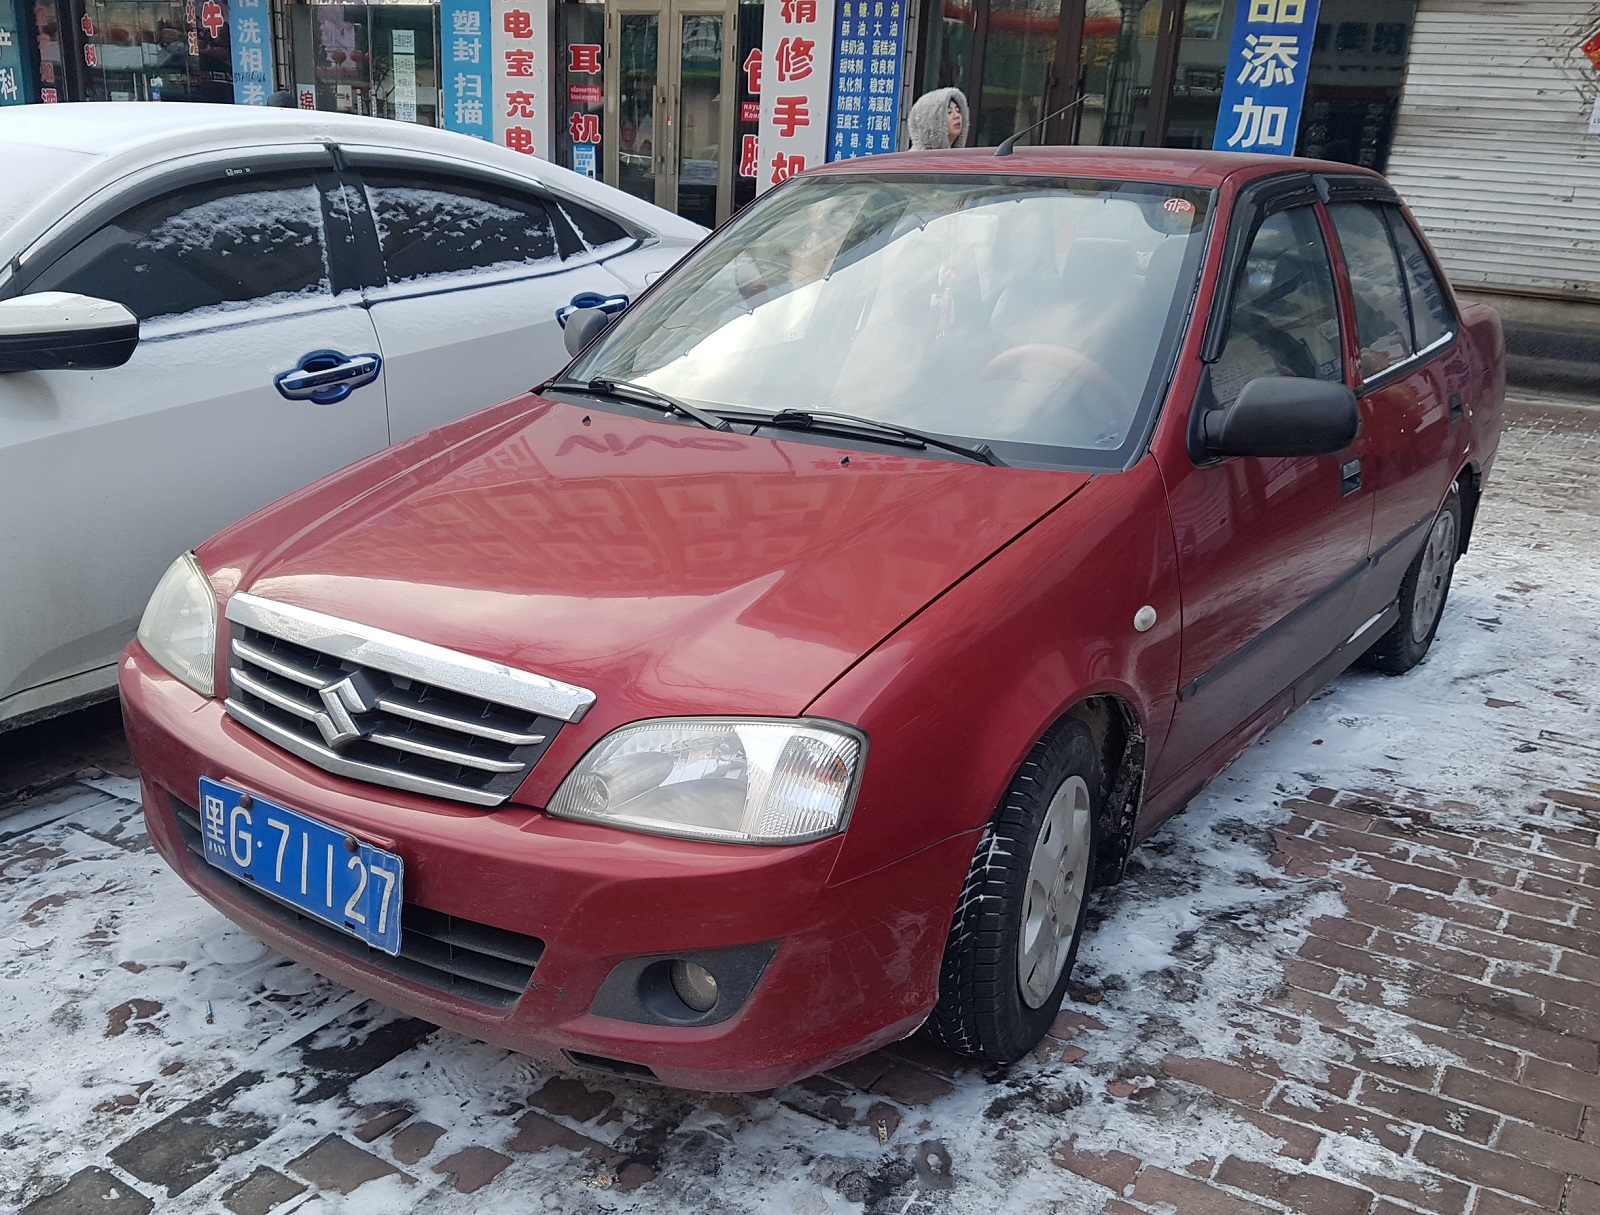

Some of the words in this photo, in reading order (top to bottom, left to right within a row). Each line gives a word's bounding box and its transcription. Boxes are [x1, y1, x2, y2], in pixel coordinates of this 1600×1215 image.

[237, 18, 262, 72] 洗相
[452, 10, 482, 63] 塑封
[454, 73, 483, 125] 扫描
[503, 0, 536, 155] 电宝充电
[569, 44, 602, 143] 耳机
